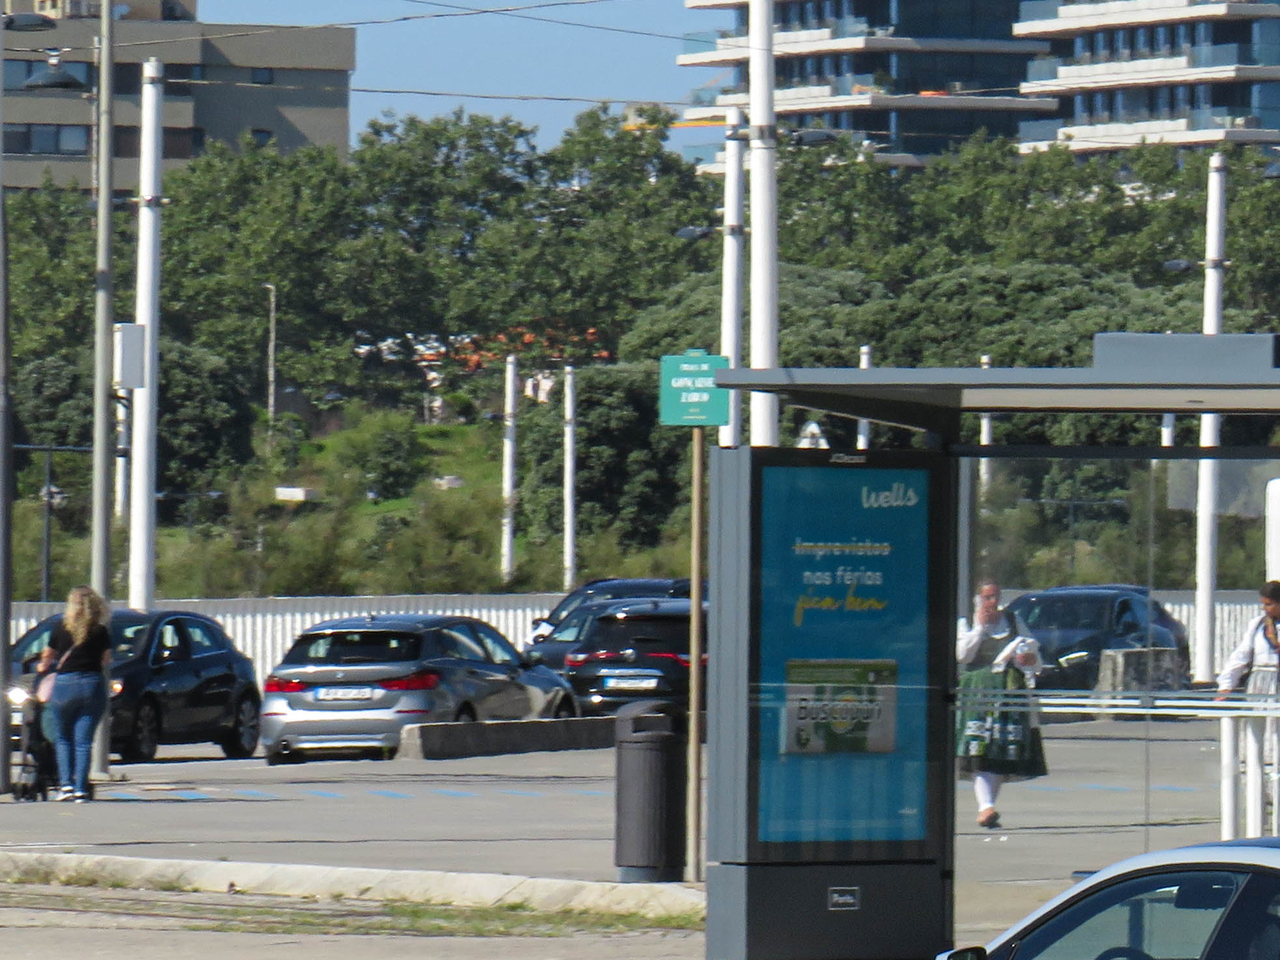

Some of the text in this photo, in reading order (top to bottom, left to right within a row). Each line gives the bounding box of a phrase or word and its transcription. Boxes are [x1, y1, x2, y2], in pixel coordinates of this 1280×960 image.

[861, 482, 920, 508] wells
[803, 565, 884, 586] nas férias
